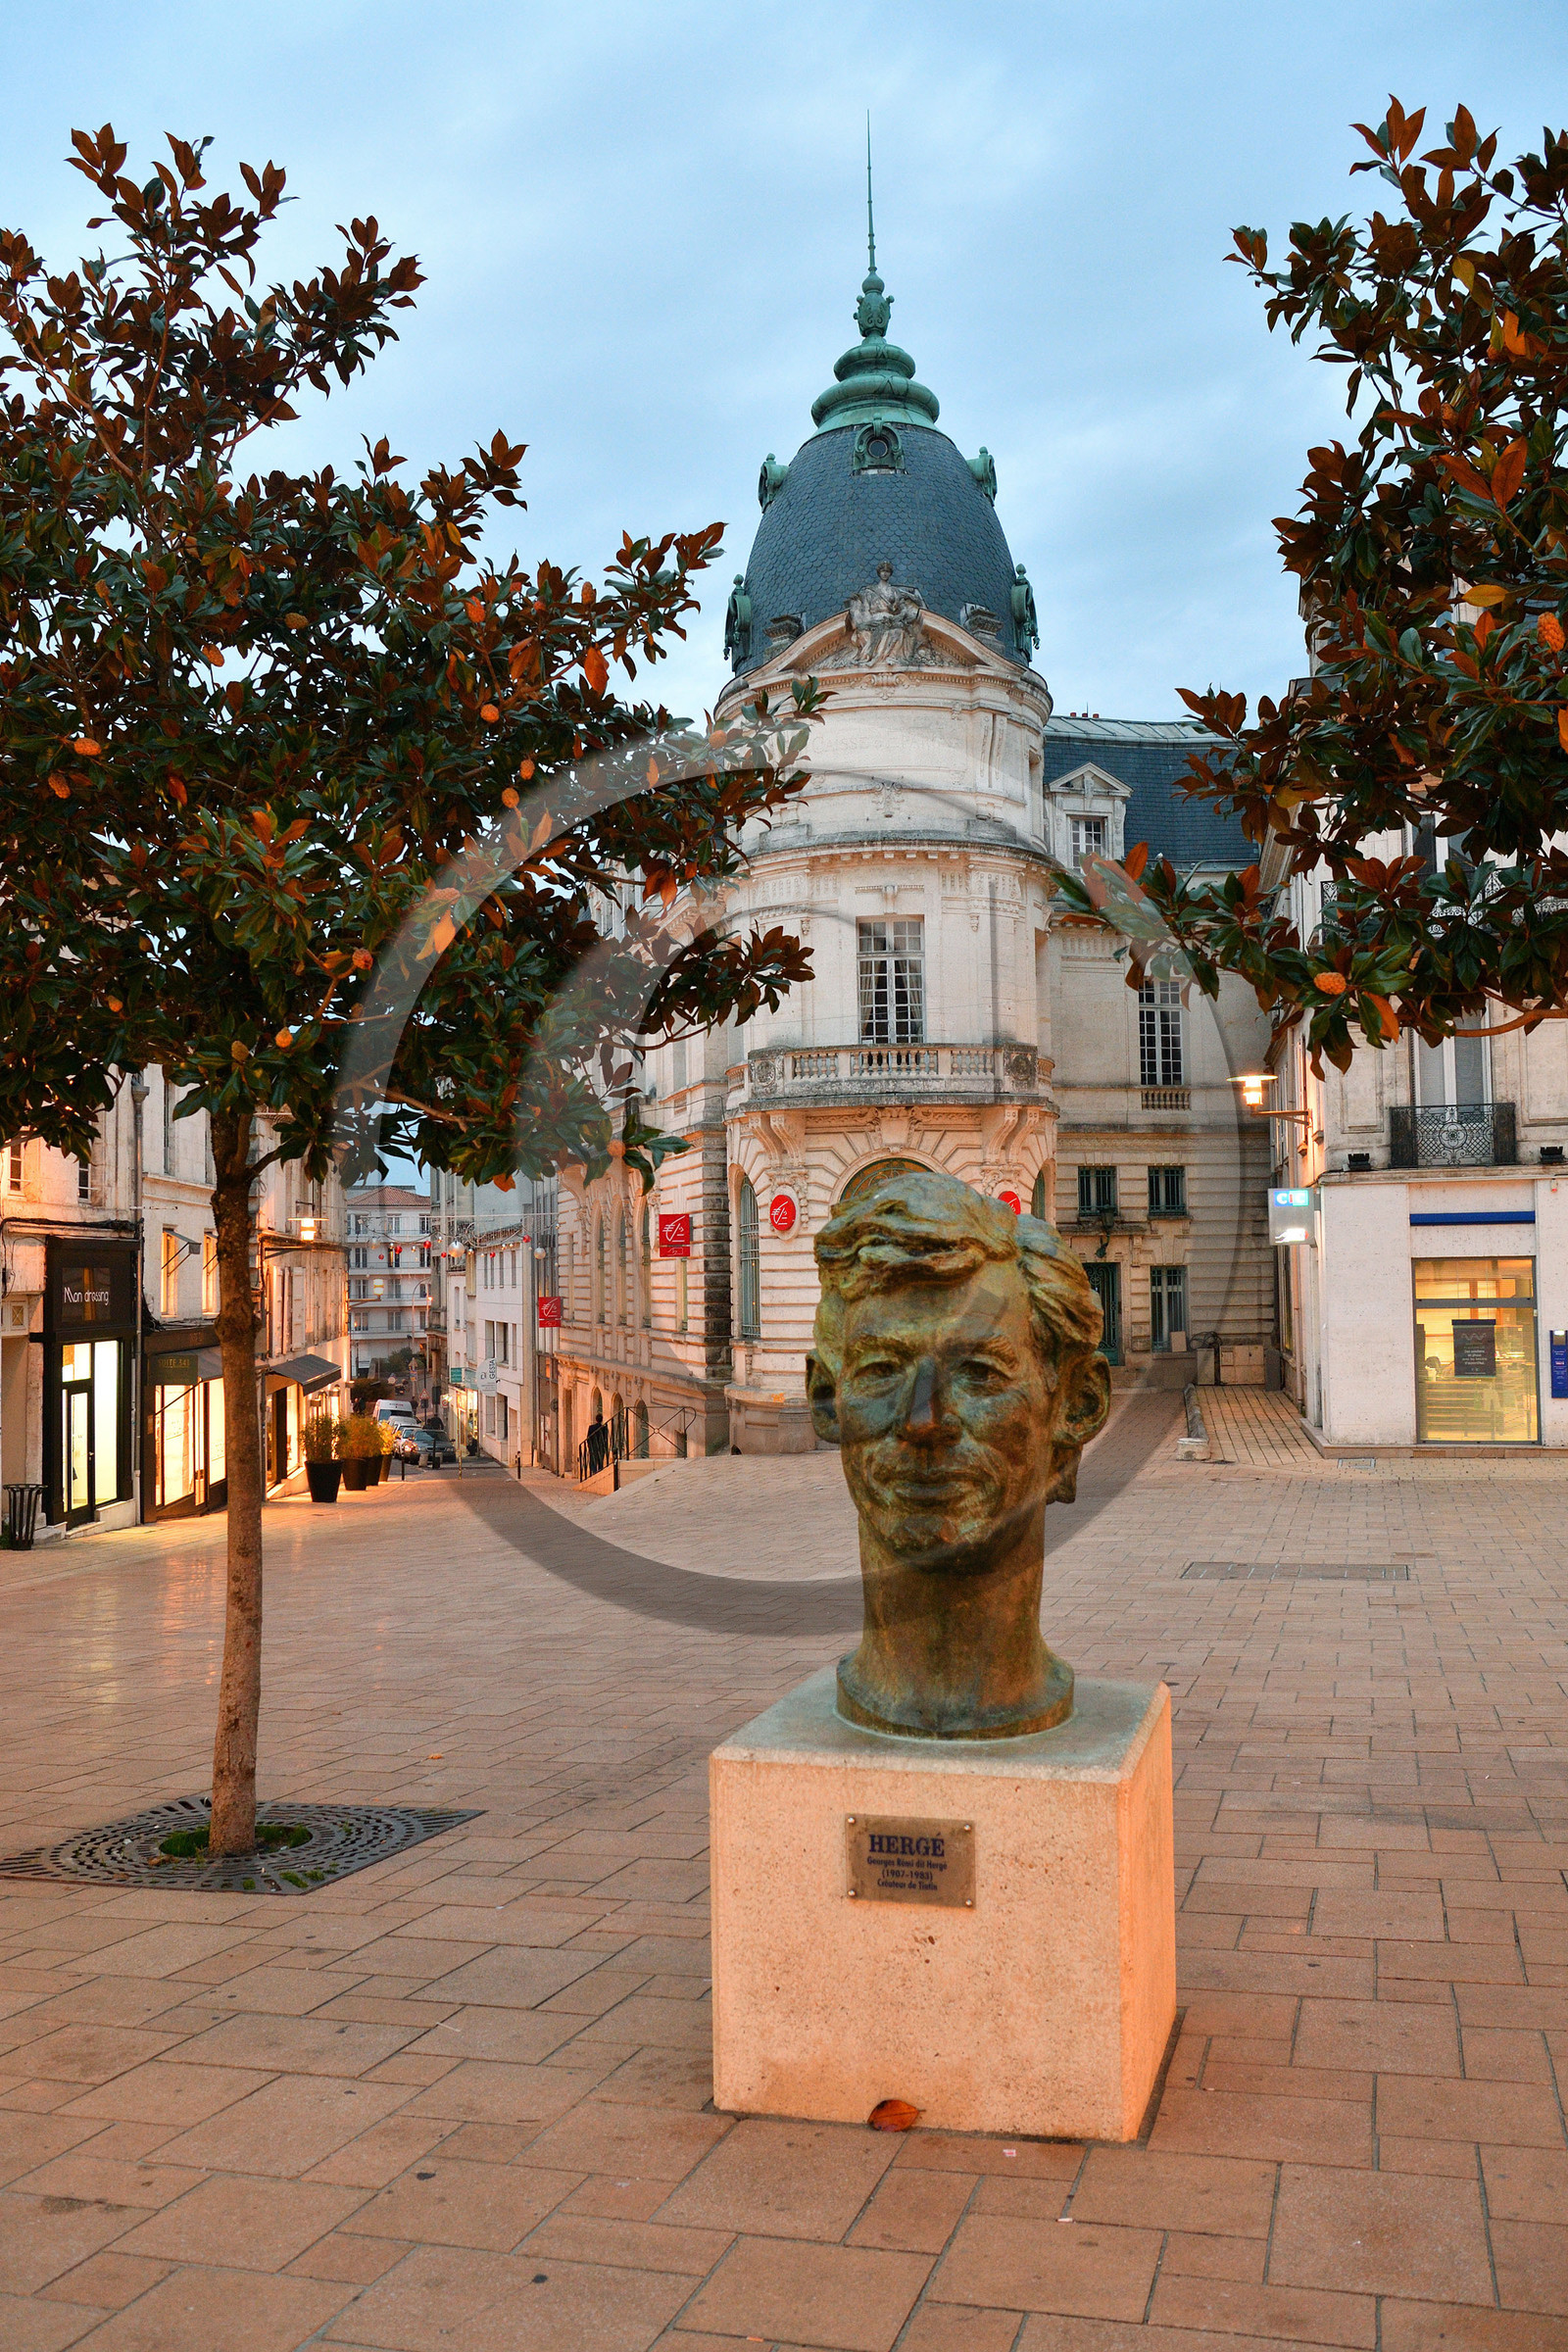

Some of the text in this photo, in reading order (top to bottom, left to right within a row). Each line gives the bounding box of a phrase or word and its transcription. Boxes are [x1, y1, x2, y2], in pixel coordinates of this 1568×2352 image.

[1276, 1193, 1305, 1204] CIC
[64, 1287, 109, 1305] Mon dressing
[869, 1833, 945, 1856] HERGÉ
[867, 1856, 895, 1868] Georges
[927, 1860, 948, 1871] Hergé
[882, 1869, 933, 1882] (1907-1983)
[877, 1879, 906, 1888] Créateur
